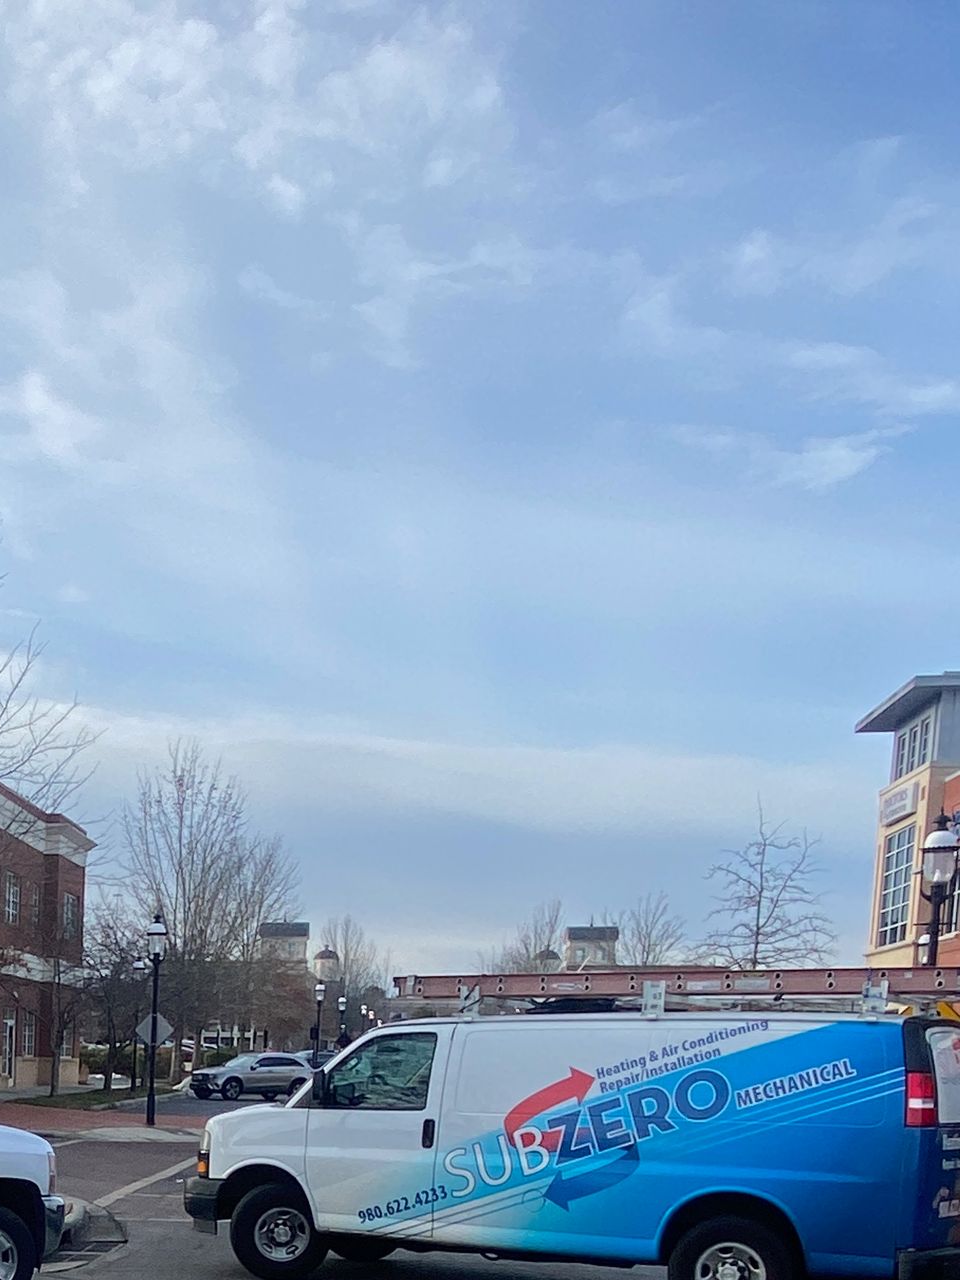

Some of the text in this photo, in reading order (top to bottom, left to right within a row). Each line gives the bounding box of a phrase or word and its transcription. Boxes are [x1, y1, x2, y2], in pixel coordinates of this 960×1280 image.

[596, 1020, 769, 1079] Heating & Air Conditioning
[735, 1059, 856, 1109] MECHANICAL
[358, 1185, 448, 1224] 980.622.4233
